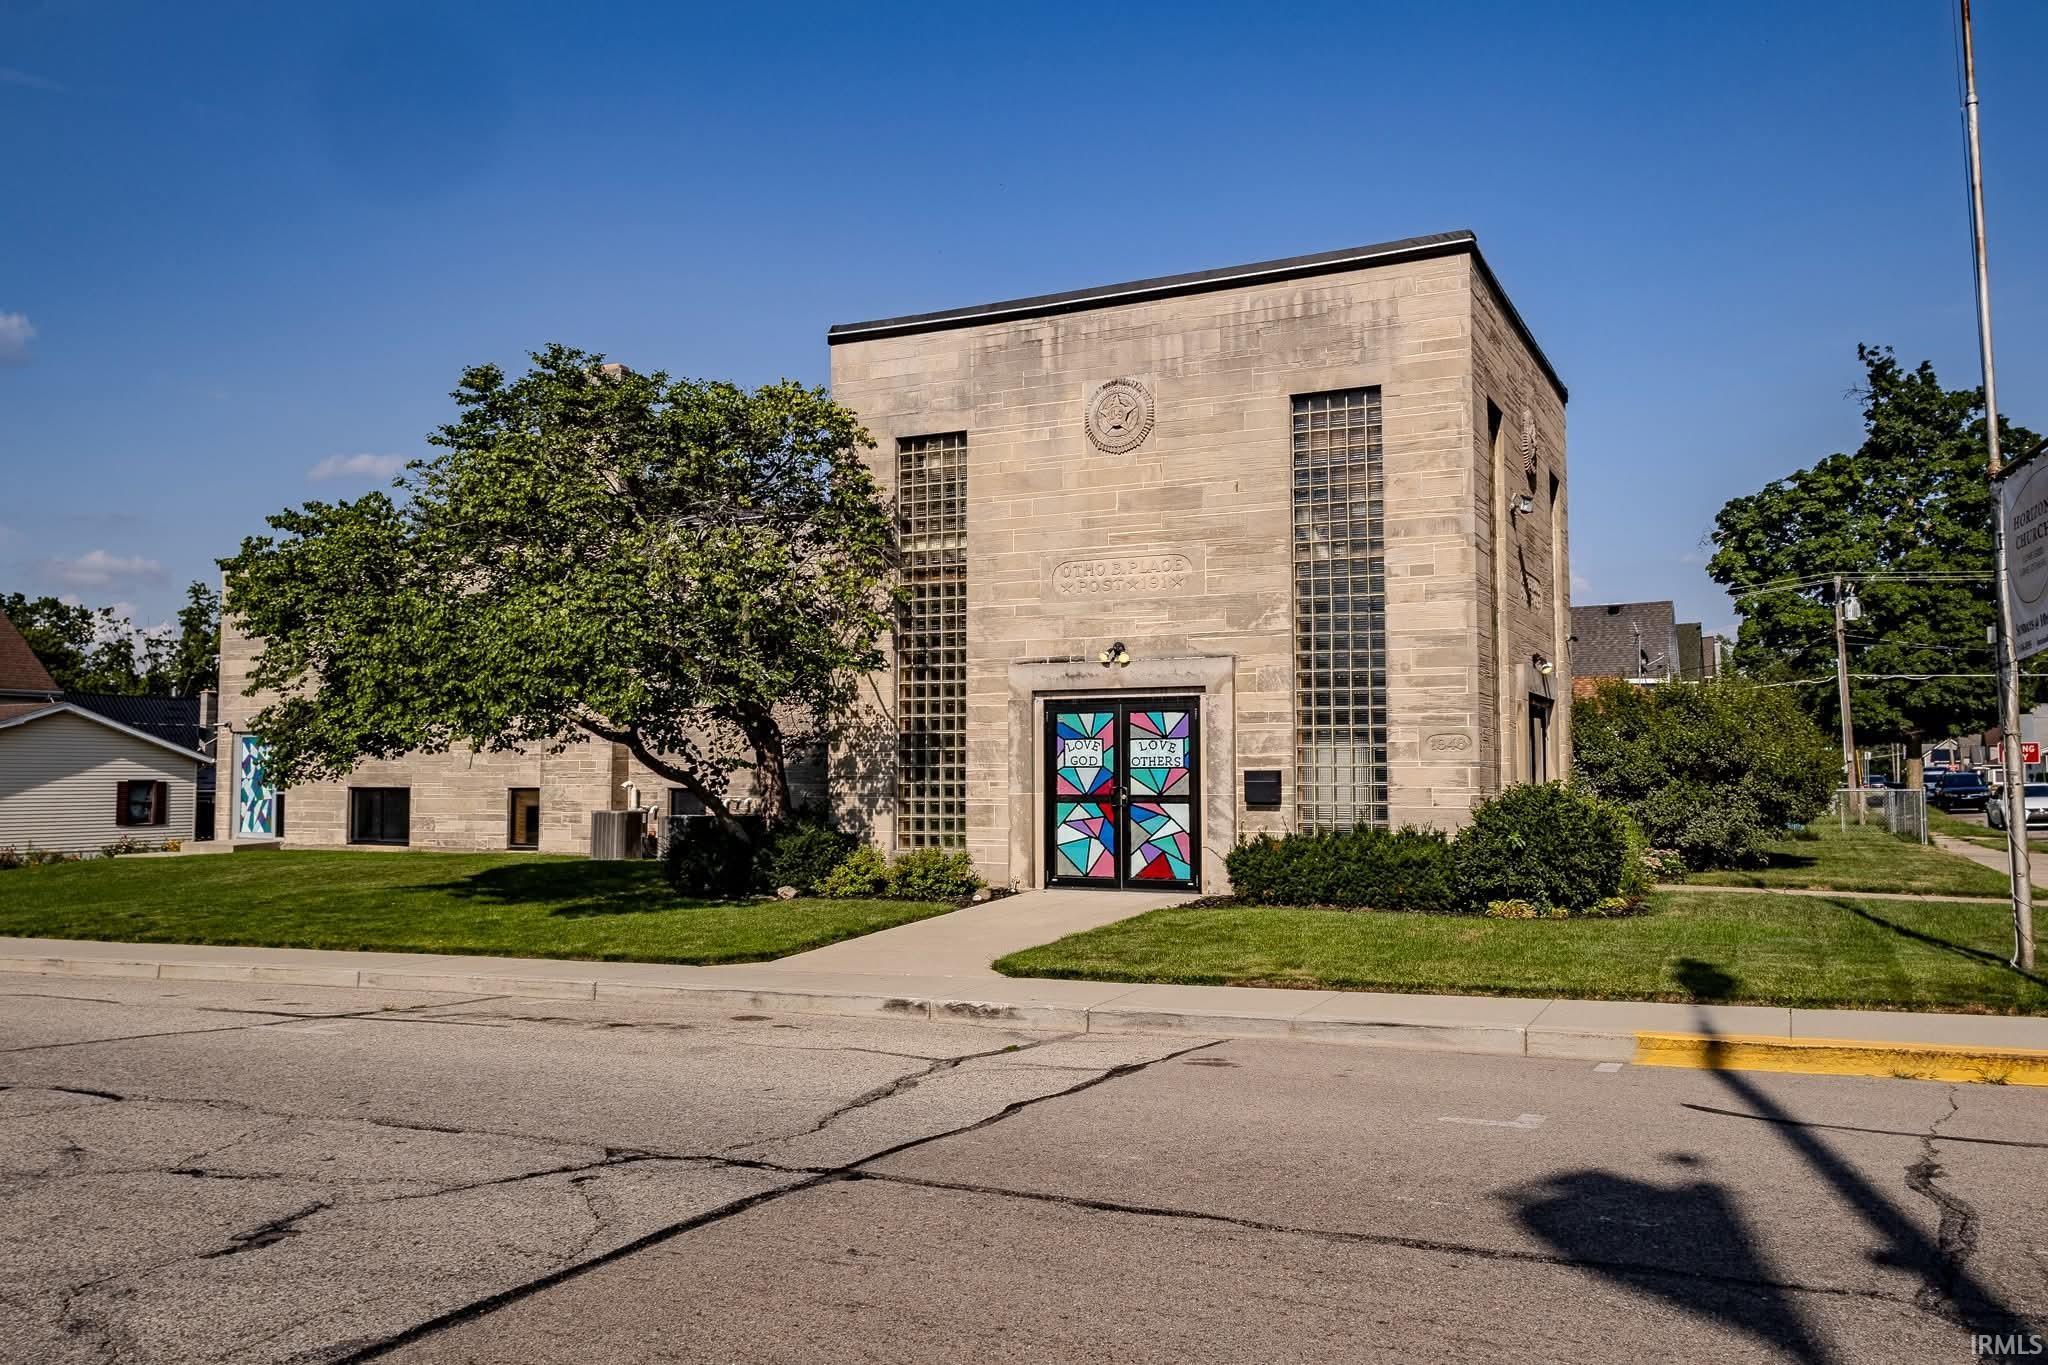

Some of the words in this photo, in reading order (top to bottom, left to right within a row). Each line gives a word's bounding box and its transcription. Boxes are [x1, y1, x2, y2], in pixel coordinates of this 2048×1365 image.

[1063, 563, 1106, 578] OTHO
[1077, 578, 1124, 594] POST
[1066, 740, 1101, 752] LOVE
[1138, 740, 1177, 754] LOVE
[1070, 755, 1098, 766] GOD
[1131, 756, 1181, 767] OTHERS
